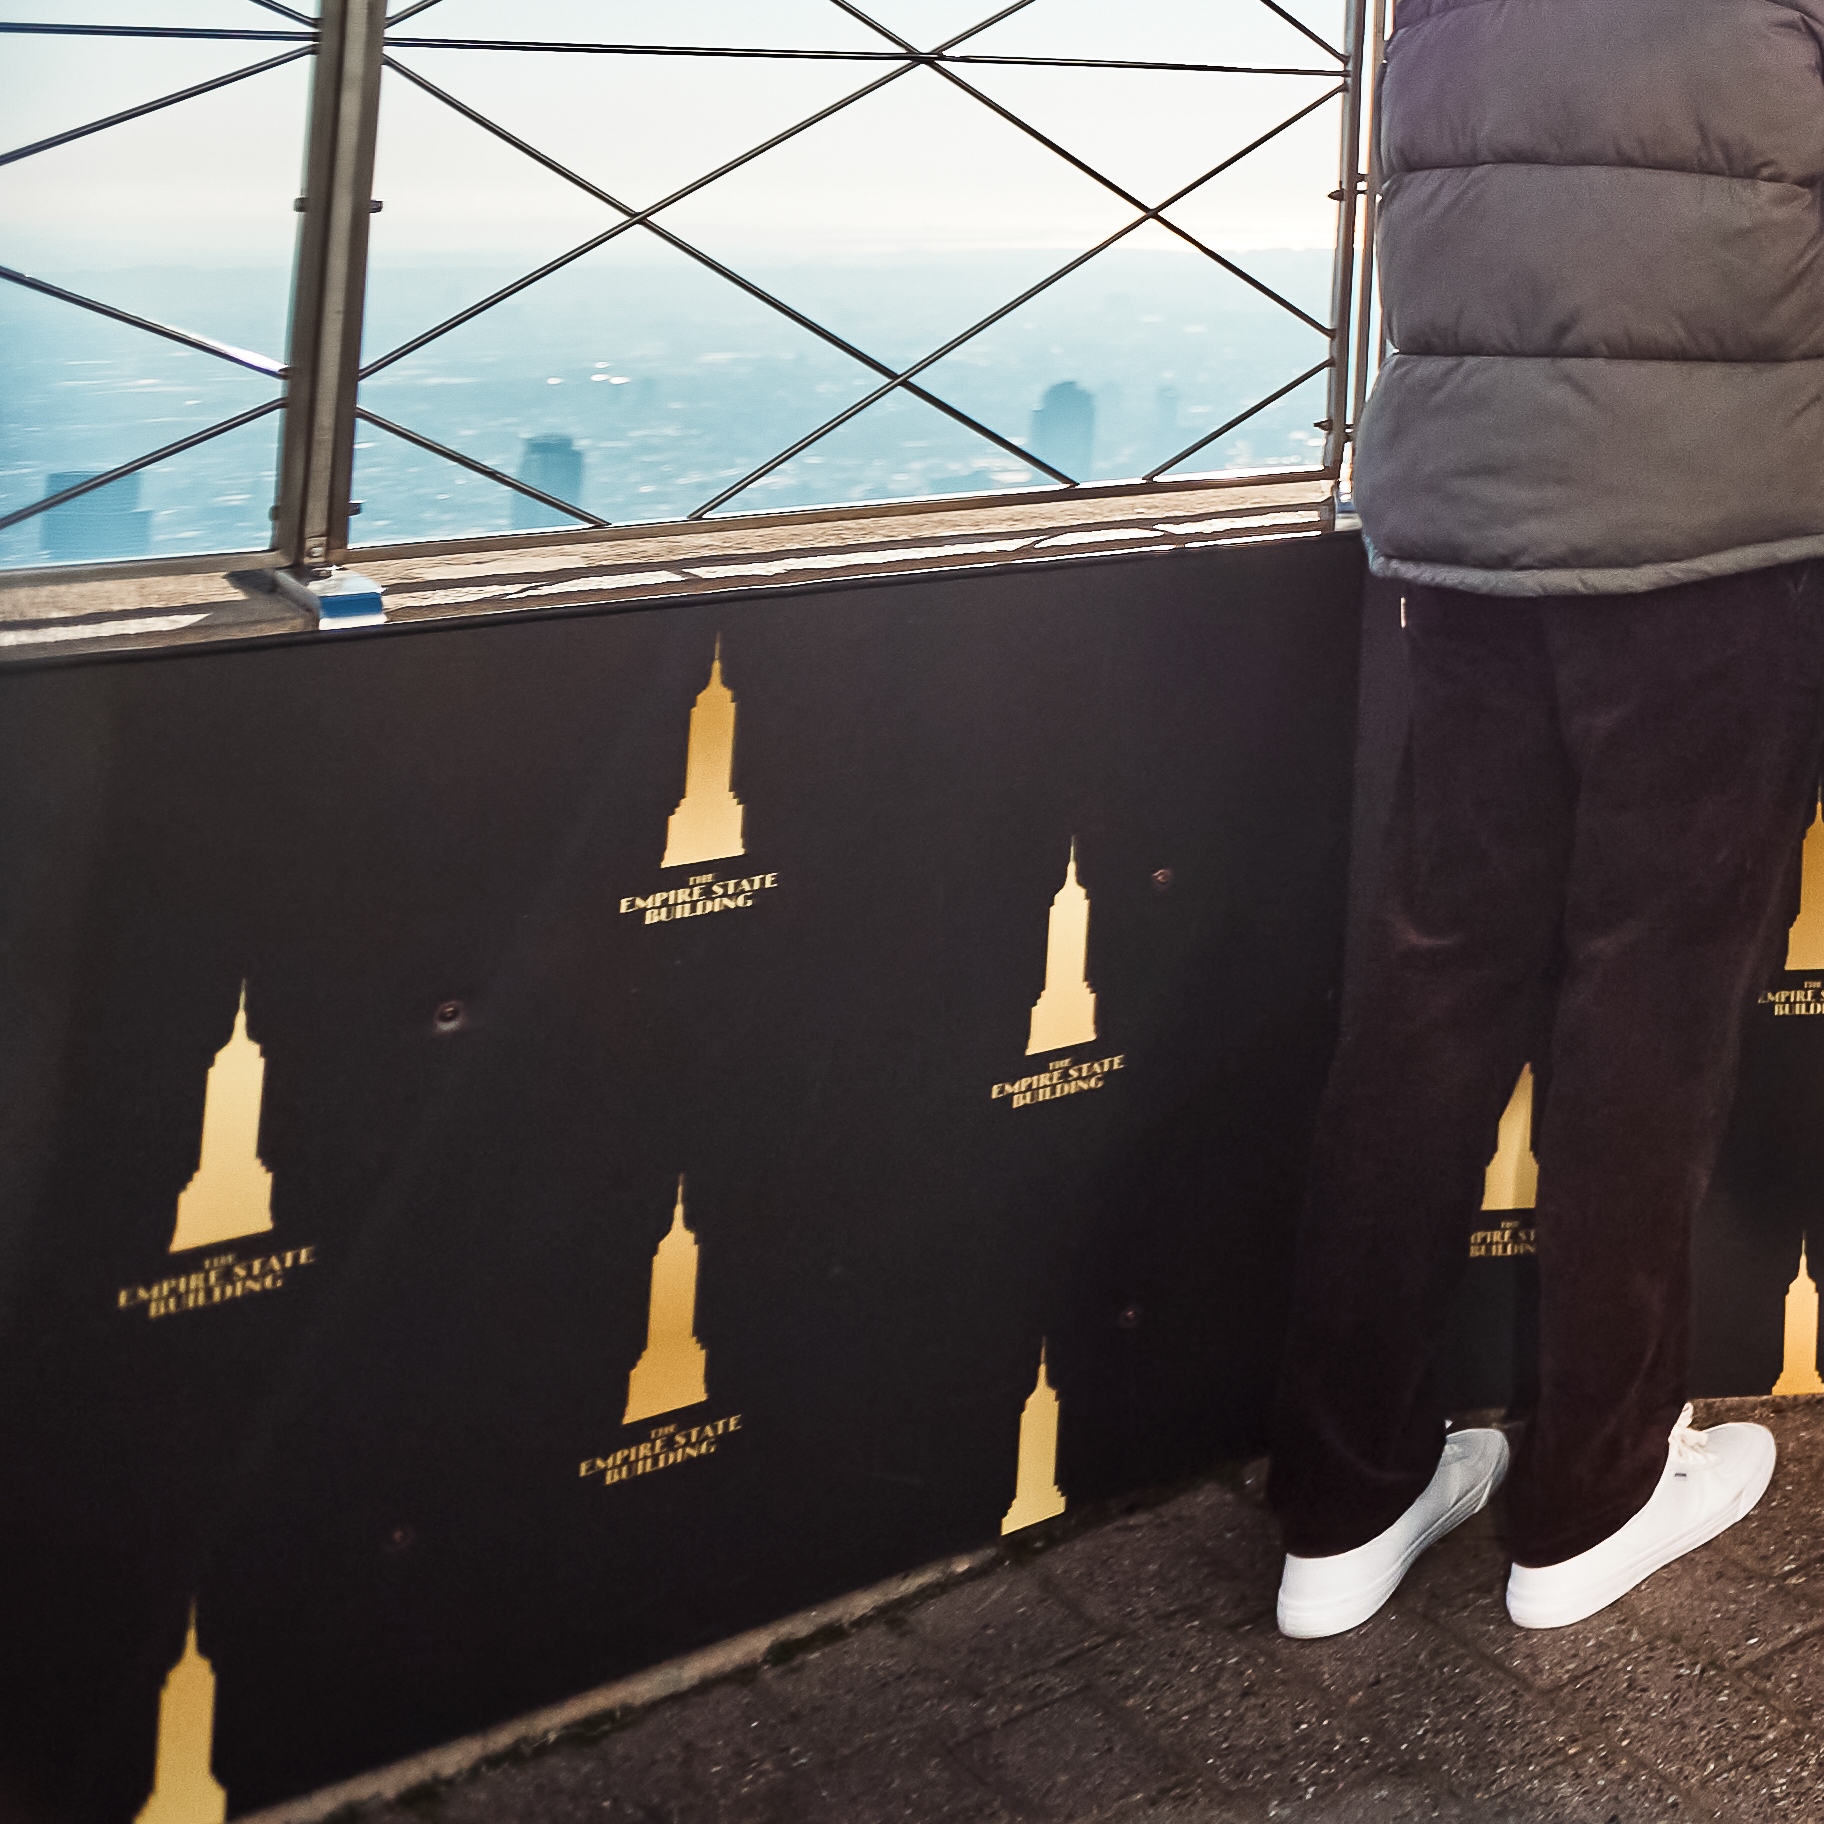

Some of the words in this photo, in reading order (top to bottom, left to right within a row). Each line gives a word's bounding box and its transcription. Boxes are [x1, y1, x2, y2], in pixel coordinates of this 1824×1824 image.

[619, 885, 705, 914] EMPIRE
[711, 872, 779, 897] STATE
[689, 873, 715, 885] THE
[644, 892, 753, 925] BUILDING
[991, 1069, 1065, 1100] EMPIRE
[1067, 1053, 1126, 1081] STATE
[1049, 1057, 1072, 1071] THE
[1012, 1074, 1104, 1109] BUILDING
[1469, 1242, 1536, 1258] BUILDIN
[117, 1269, 227, 1309] EMPIRE
[232, 1245, 316, 1280] STATE
[148, 1275, 283, 1319] BUILDING
[578, 1437, 668, 1478] EMPIRE
[673, 1413, 742, 1448] STATE
[604, 1438, 717, 1486] BUILDING
